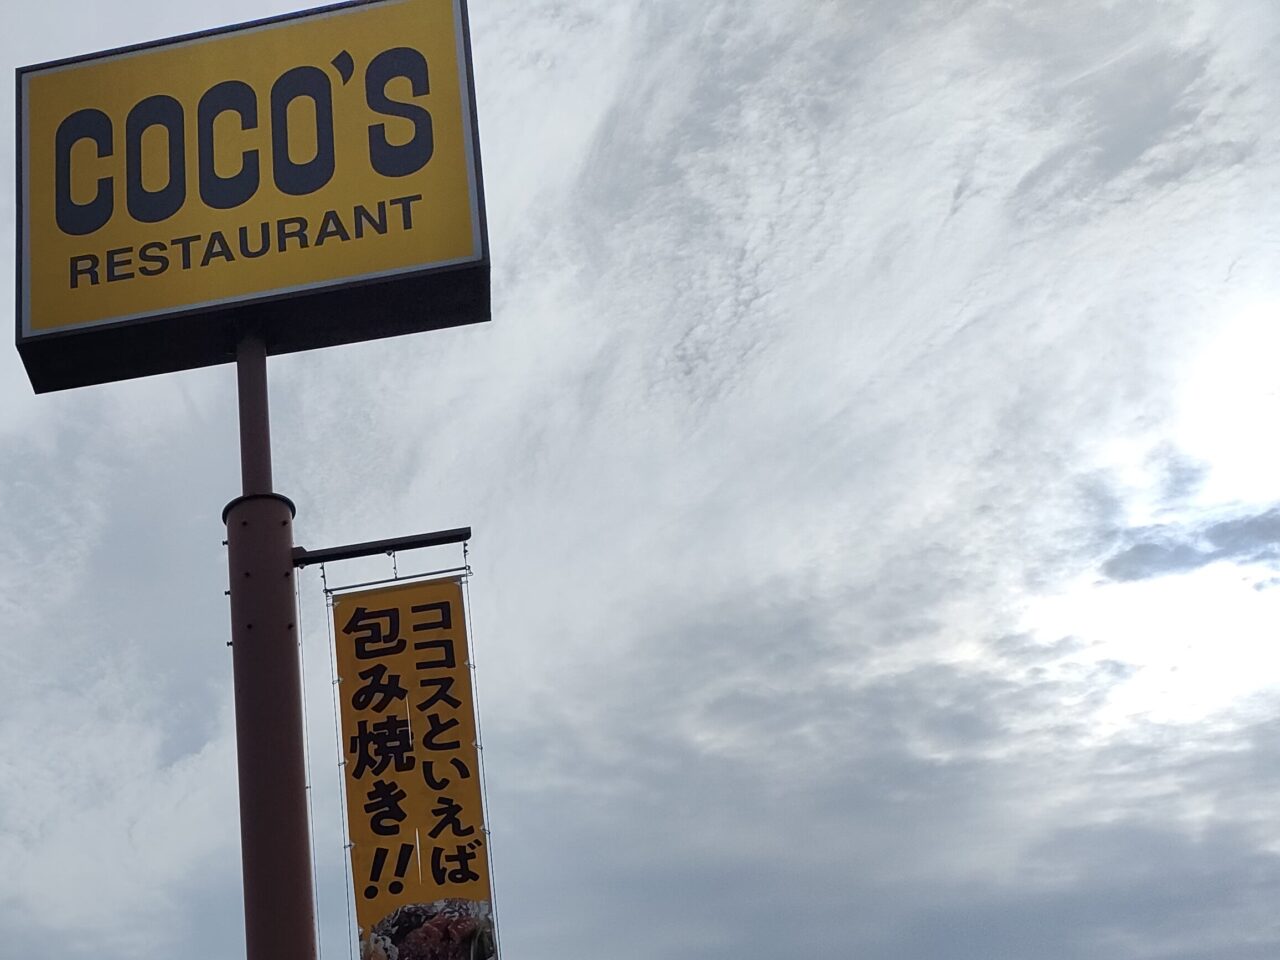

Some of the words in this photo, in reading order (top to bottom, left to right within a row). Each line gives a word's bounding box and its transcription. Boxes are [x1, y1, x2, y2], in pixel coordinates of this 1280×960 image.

[55, 46, 434, 236] COCO'S
[70, 194, 422, 289] RESTAURANT
[411, 600, 481, 885] ココスといえば
